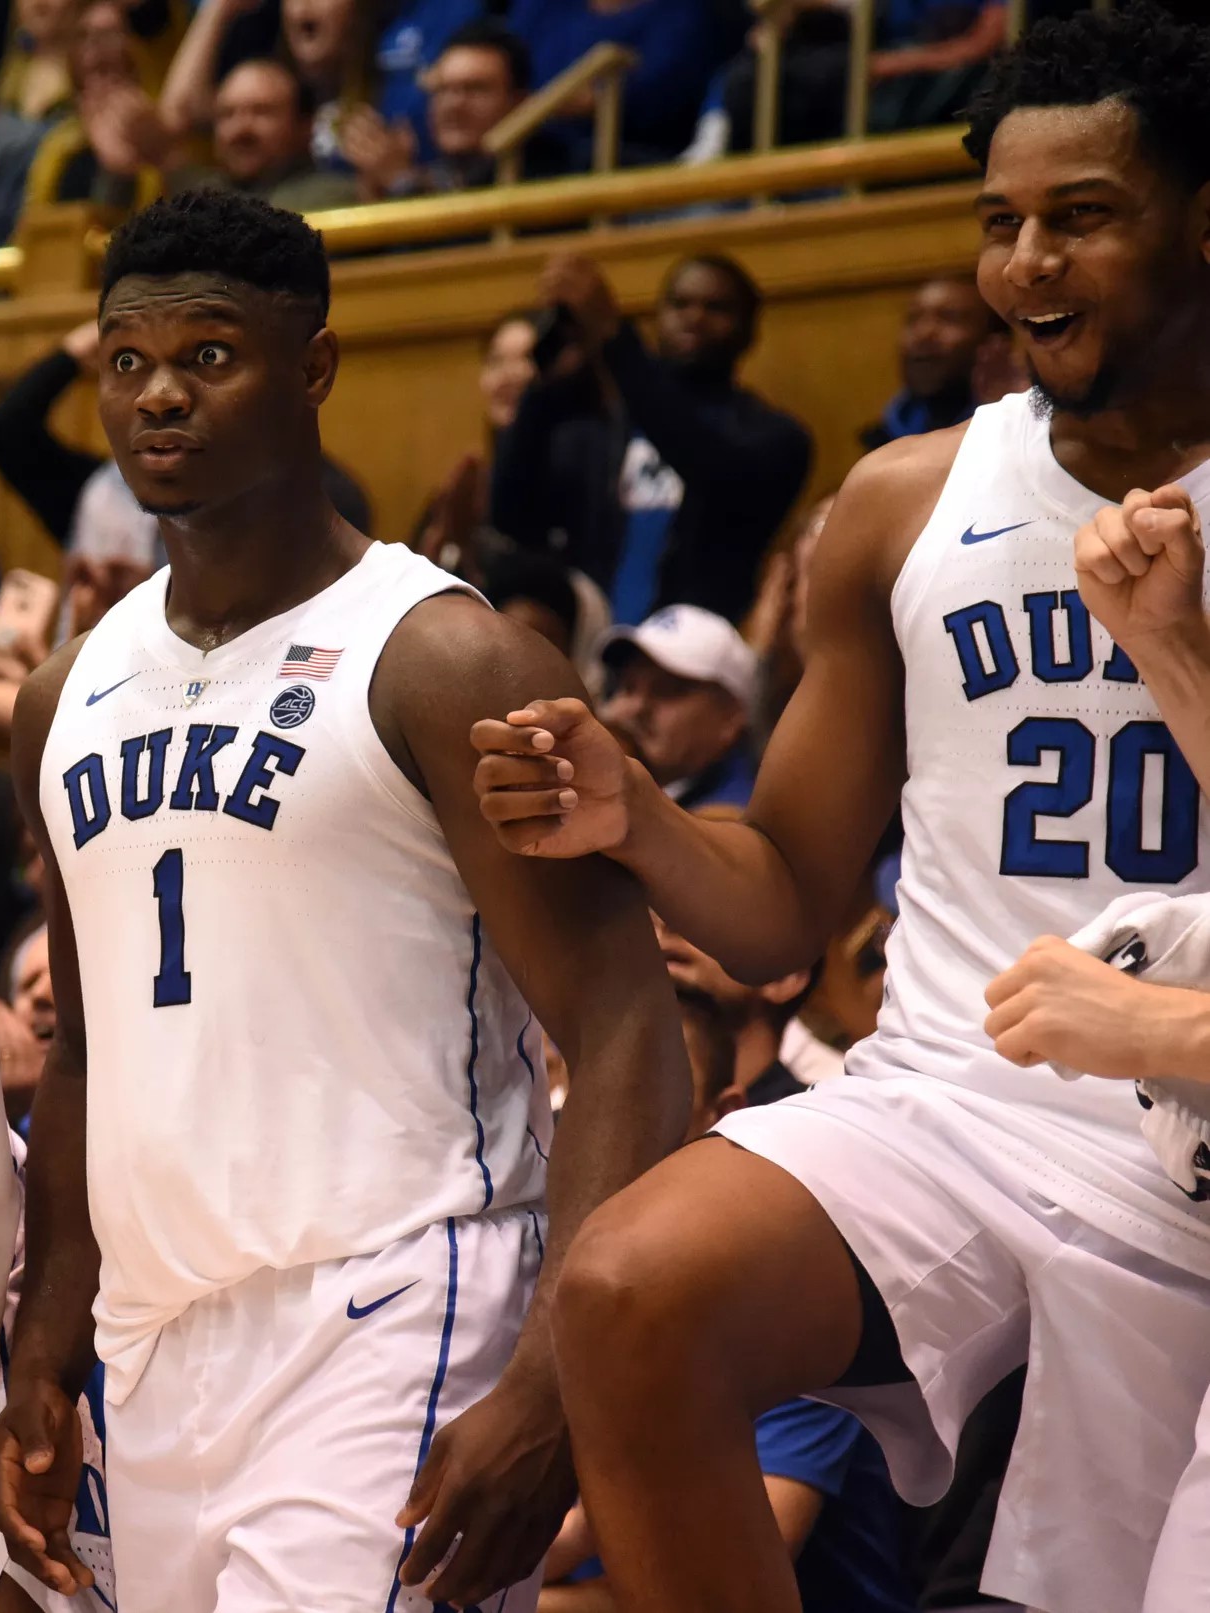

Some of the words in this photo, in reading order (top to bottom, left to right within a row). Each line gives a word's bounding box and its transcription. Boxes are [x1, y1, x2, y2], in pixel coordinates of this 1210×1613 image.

[277, 698, 313, 709] ACC
[943, 588, 1148, 702] DU
[62, 723, 307, 852] DUKE
[999, 716, 1200, 884] 20
[151, 846, 192, 1009] 1
